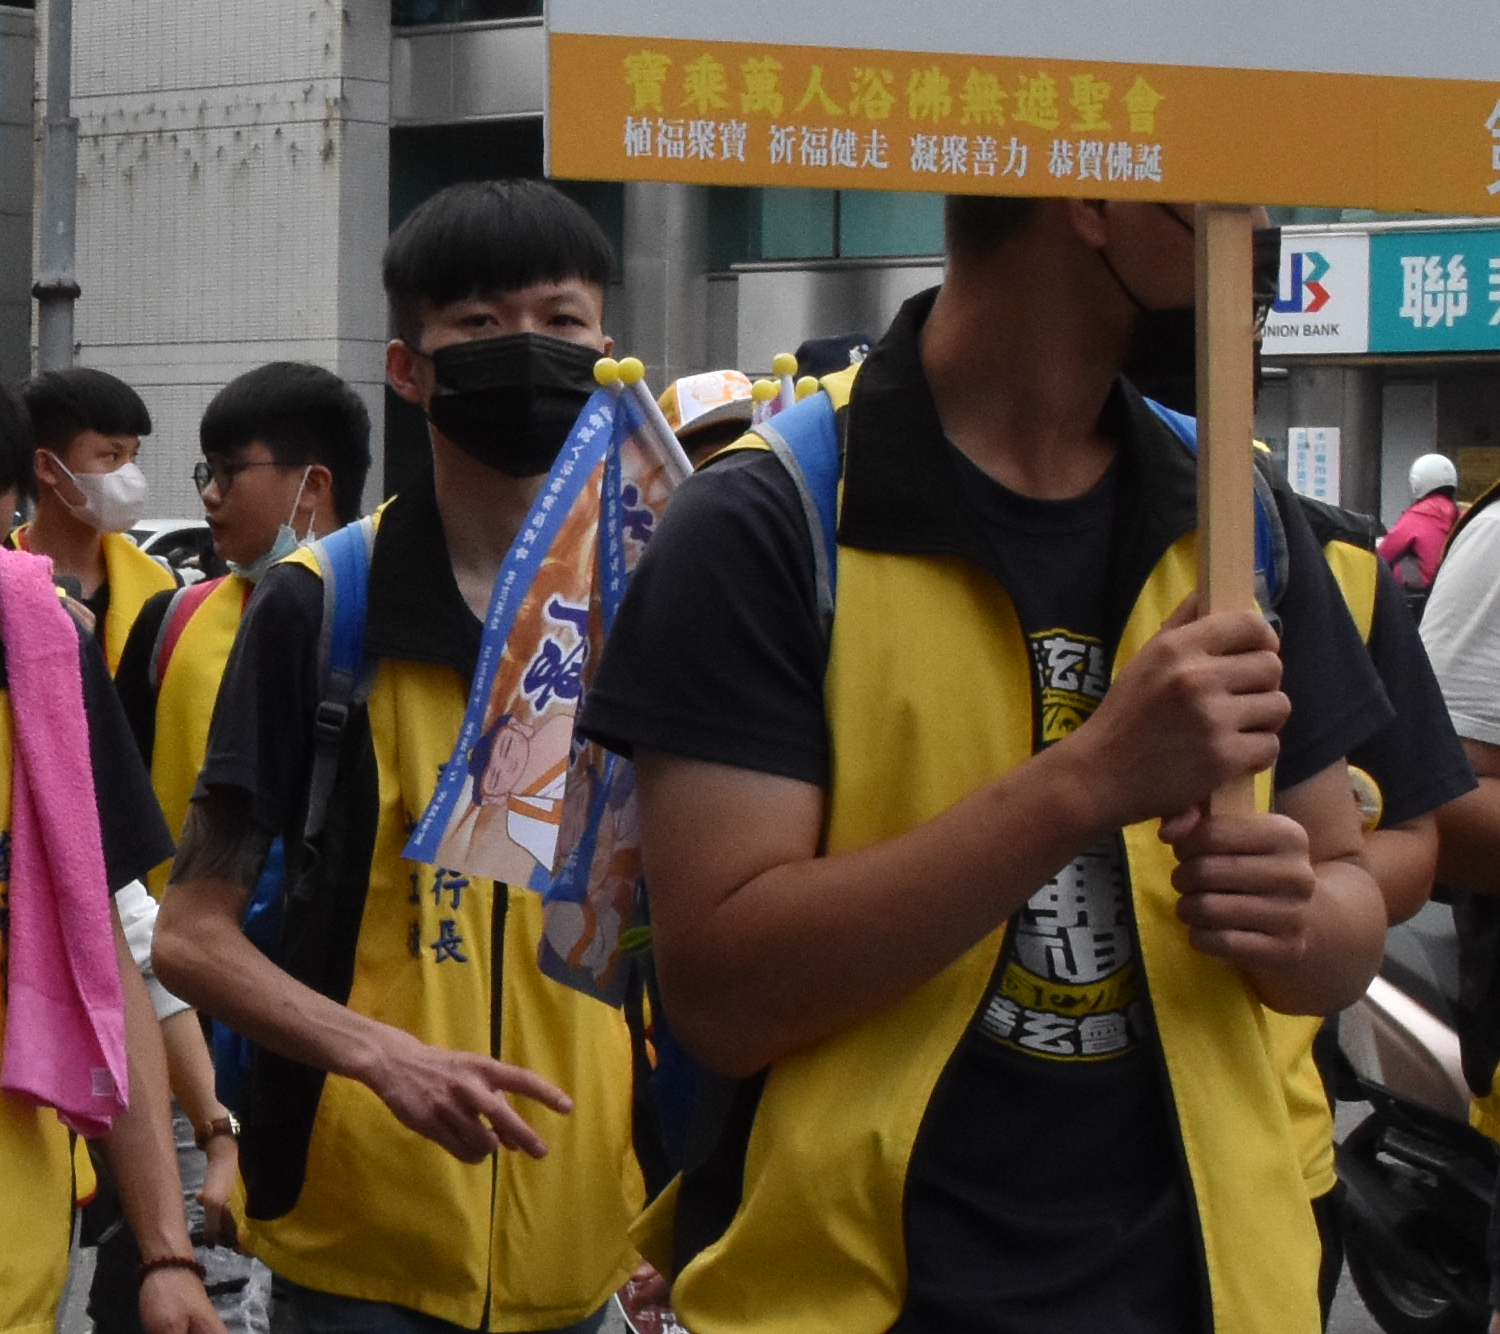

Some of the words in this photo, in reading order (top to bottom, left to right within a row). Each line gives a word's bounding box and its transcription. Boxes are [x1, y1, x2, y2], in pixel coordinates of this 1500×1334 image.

[623, 116, 749, 163] 植福聚寶
[768, 123, 890, 170] 祈福健走
[909, 133, 1030, 178] 凝聚善力
[1047, 138, 1164, 184] 恭賀佛誕
[1302, 323, 1340, 337] BANK
